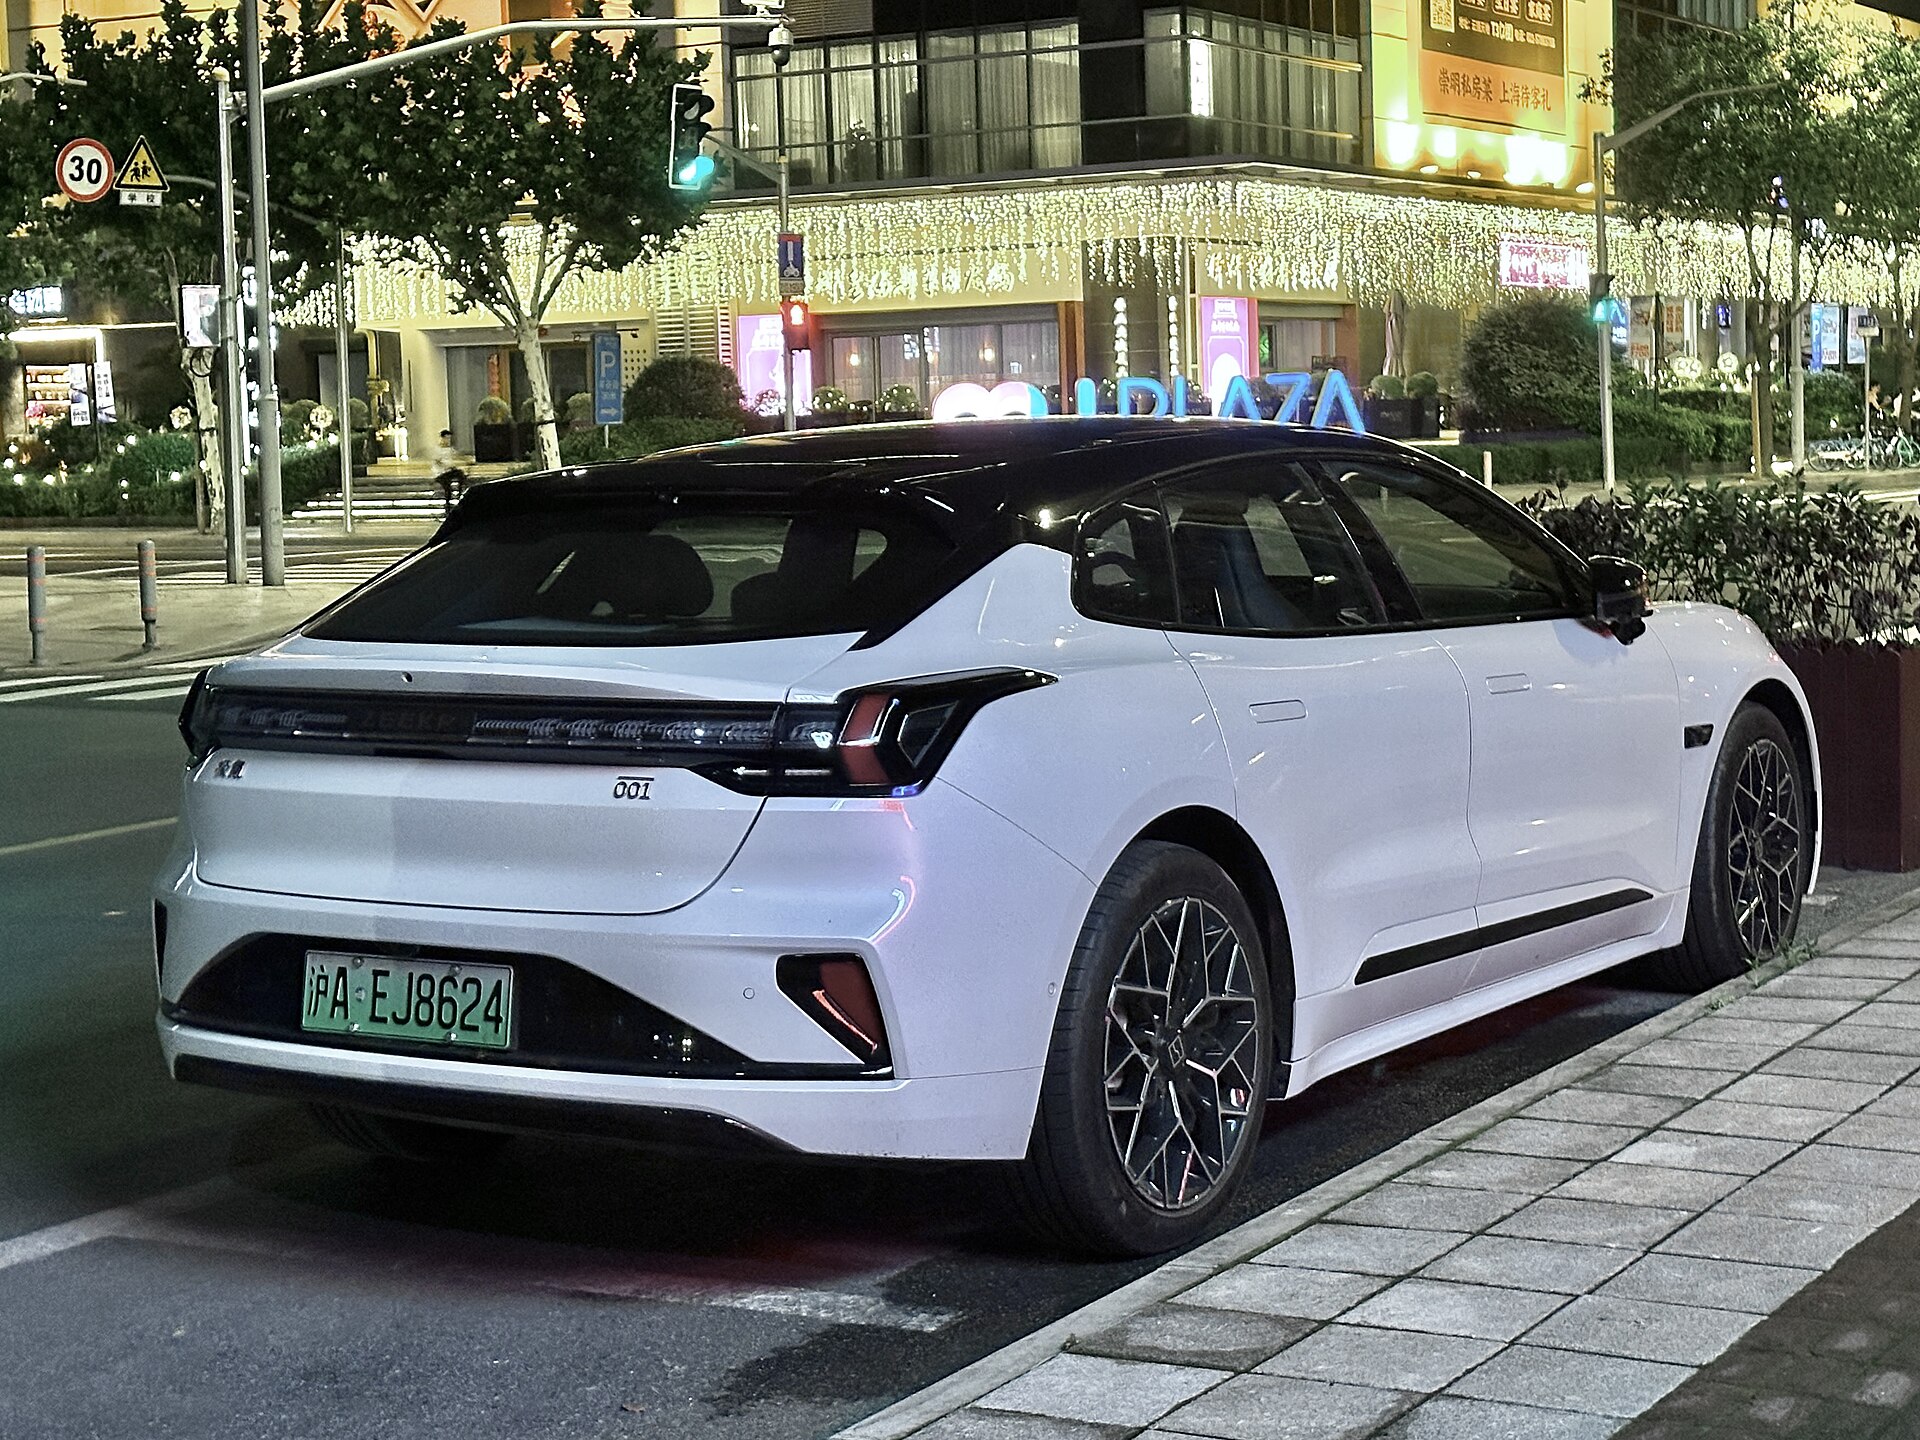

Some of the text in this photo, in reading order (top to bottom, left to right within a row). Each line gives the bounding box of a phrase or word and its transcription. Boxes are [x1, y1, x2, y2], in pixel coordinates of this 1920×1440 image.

[1439, 67, 1551, 111] 崇明私房菜 上海待客礼
[69, 155, 102, 184] 30
[128, 192, 155, 204] 学校
[600, 350, 616, 378] P
[613, 781, 651, 800] 001
